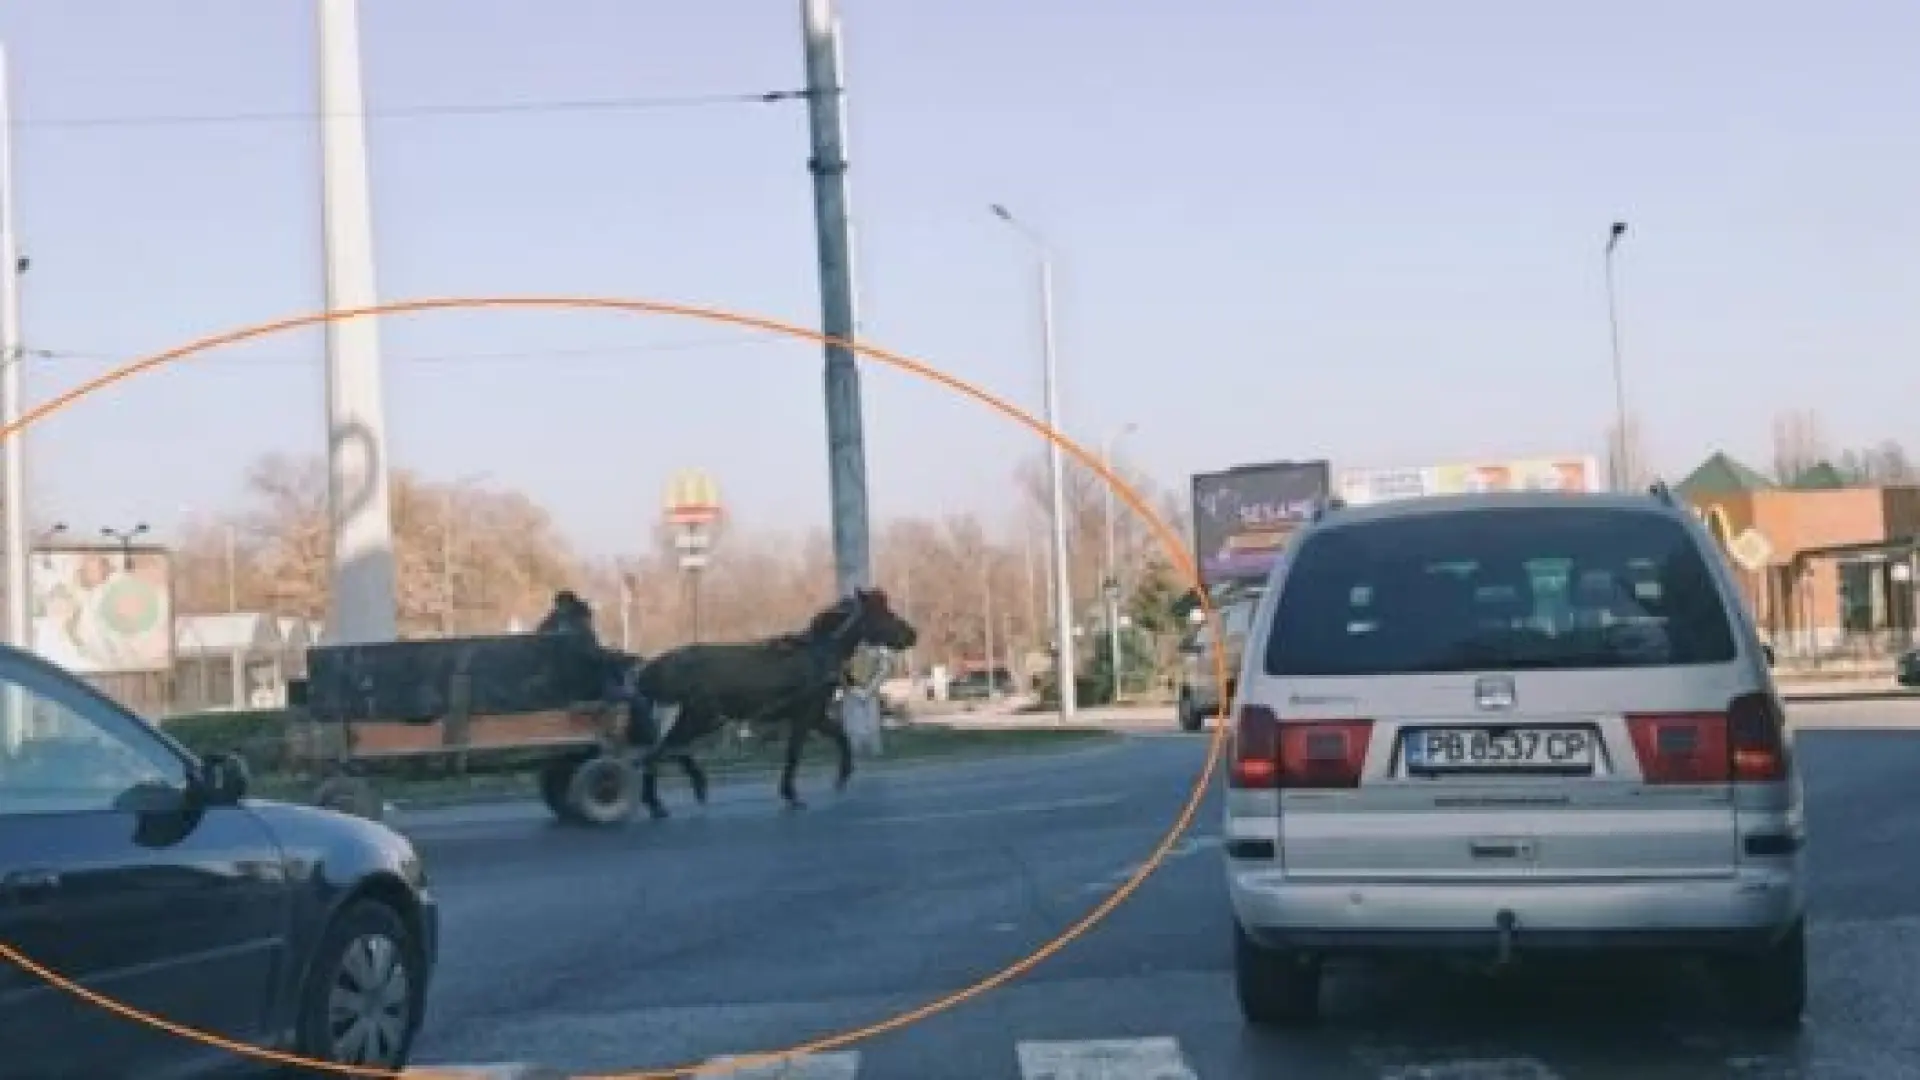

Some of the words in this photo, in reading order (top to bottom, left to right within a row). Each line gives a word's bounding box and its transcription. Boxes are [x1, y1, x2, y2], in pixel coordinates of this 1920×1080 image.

[1427, 732, 1465, 759] PB
[1470, 732, 1540, 760] 8537
[1546, 732, 1585, 759] CP
